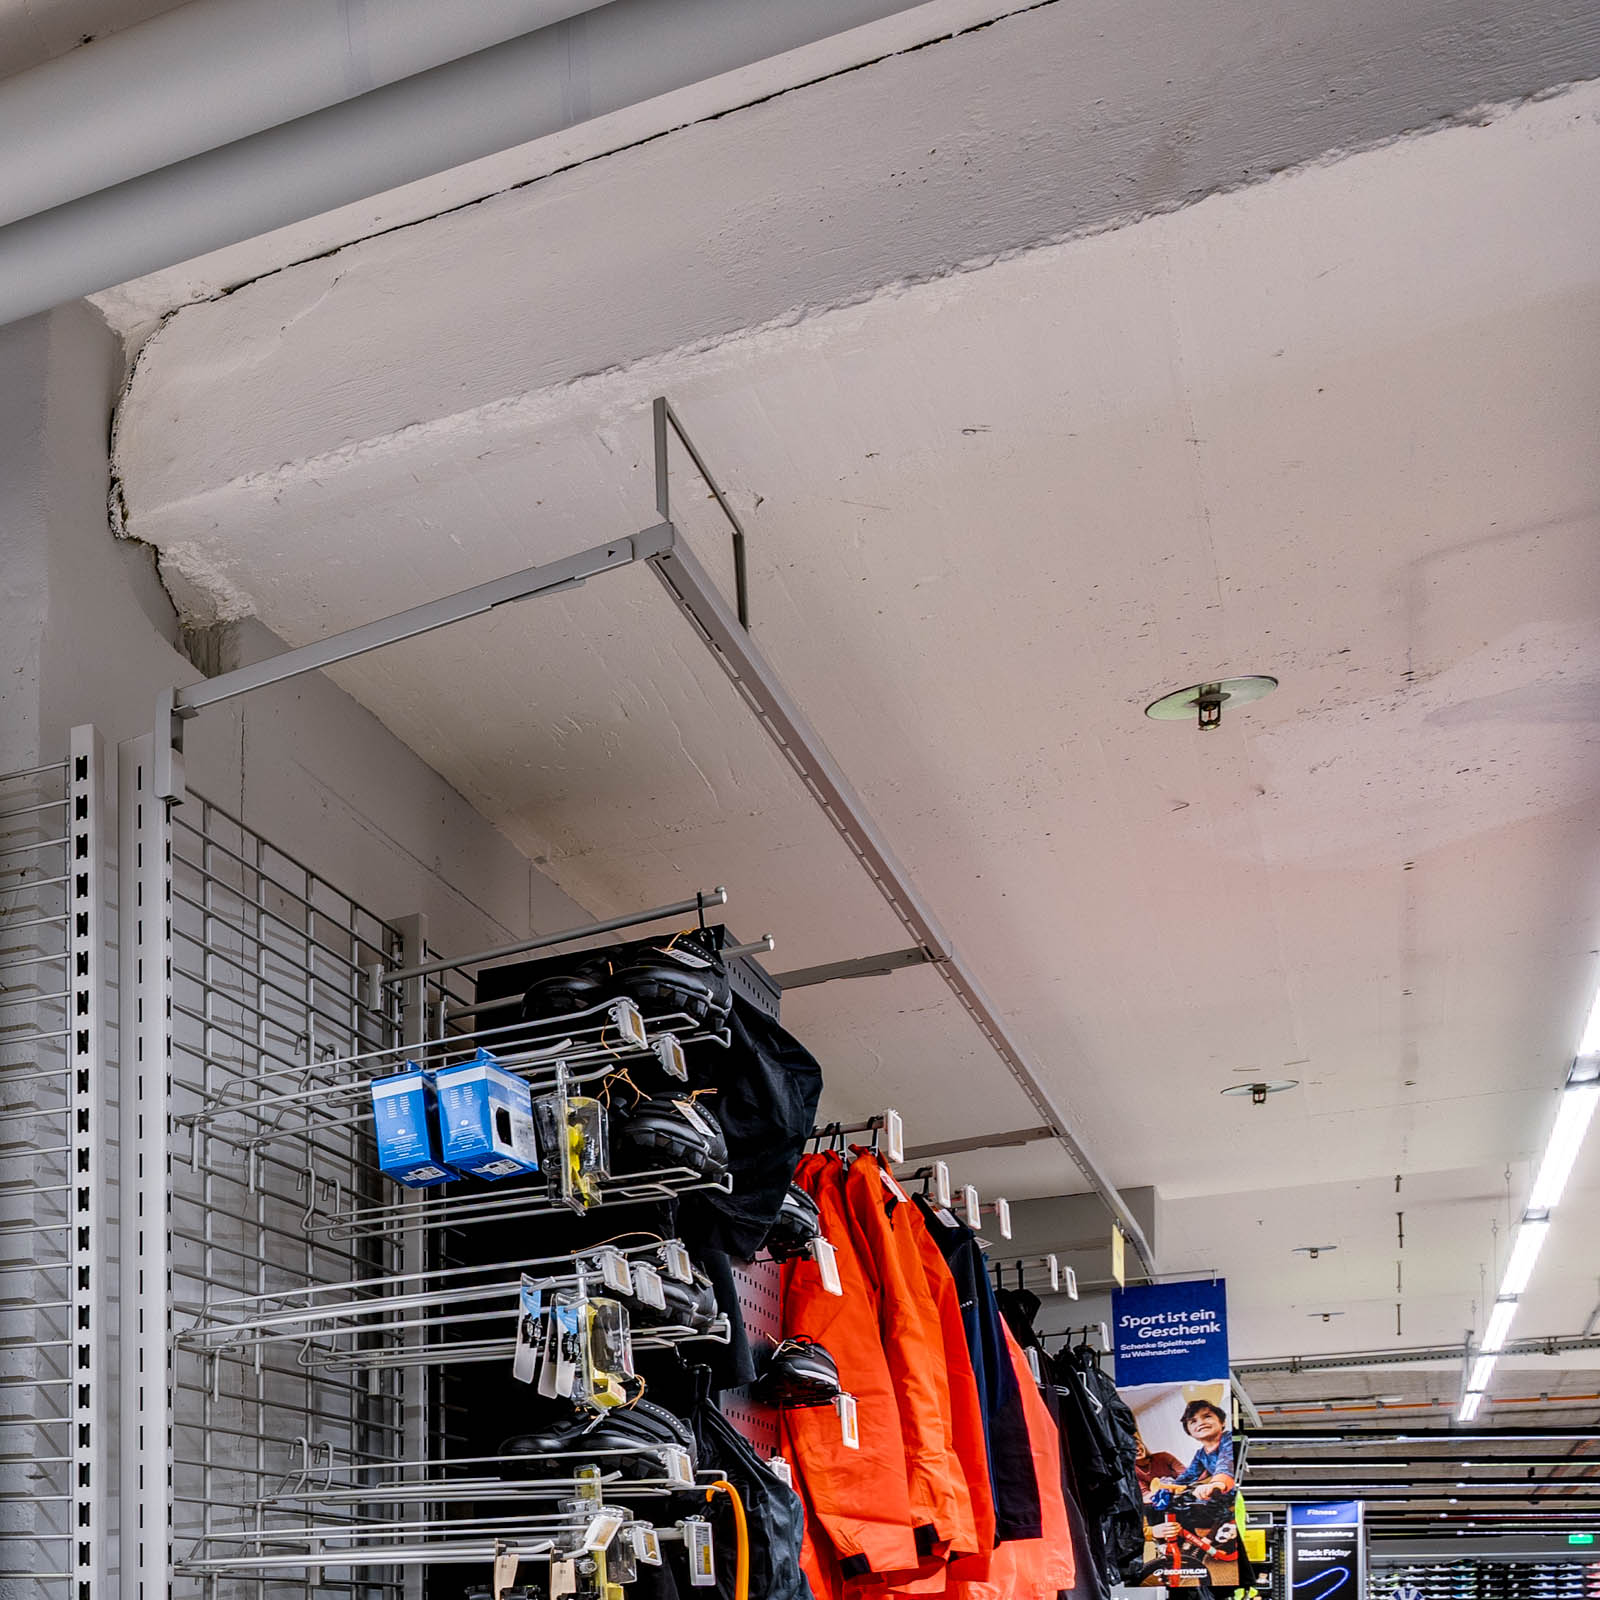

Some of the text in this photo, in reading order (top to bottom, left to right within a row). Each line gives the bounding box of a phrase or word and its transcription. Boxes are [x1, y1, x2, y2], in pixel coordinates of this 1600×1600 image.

[1119, 1309, 1216, 1329] Sport ist ein
[1138, 1321, 1221, 1339] Geschenk
[1120, 1338, 1207, 1351] Schenke Spielfreude
[1131, 1348, 1190, 1357] Weihnachten.
[1298, 1549, 1352, 1557] Black Friday
